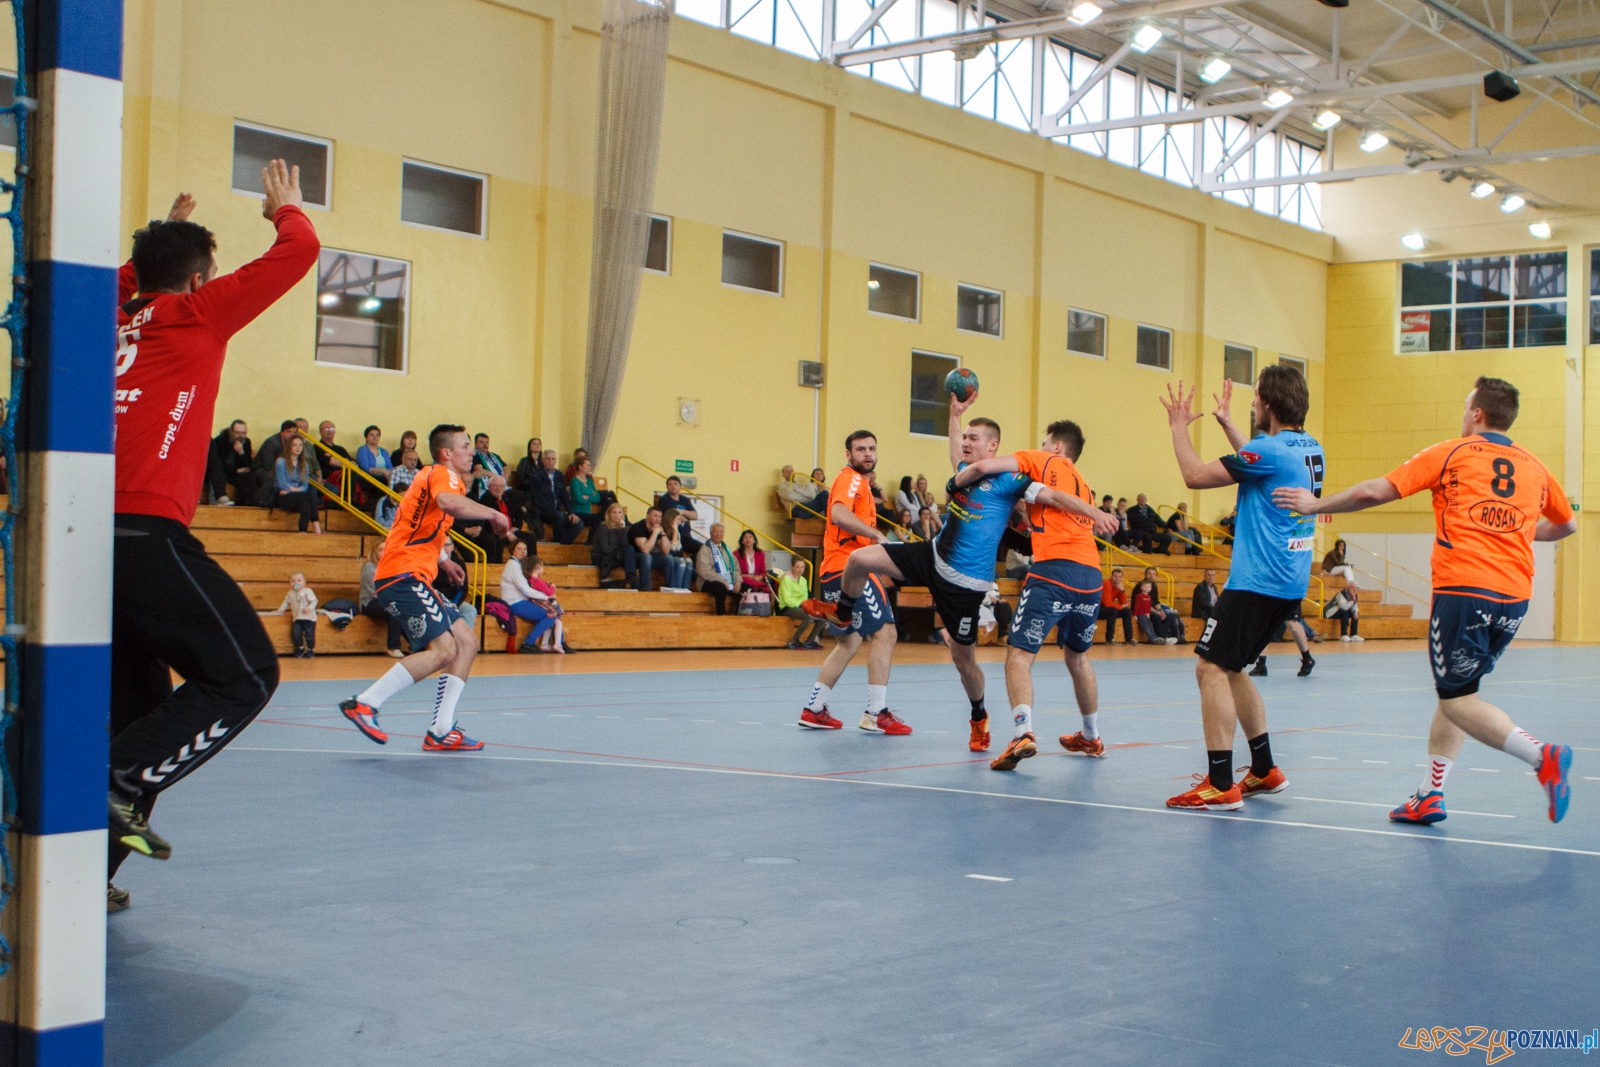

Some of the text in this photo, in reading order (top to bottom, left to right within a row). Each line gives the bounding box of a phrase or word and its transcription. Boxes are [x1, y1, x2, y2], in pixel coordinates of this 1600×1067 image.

[158, 390, 190, 460] carpe diem
[1491, 457, 1516, 498] 8
[1480, 505, 1517, 529] ROSAN
